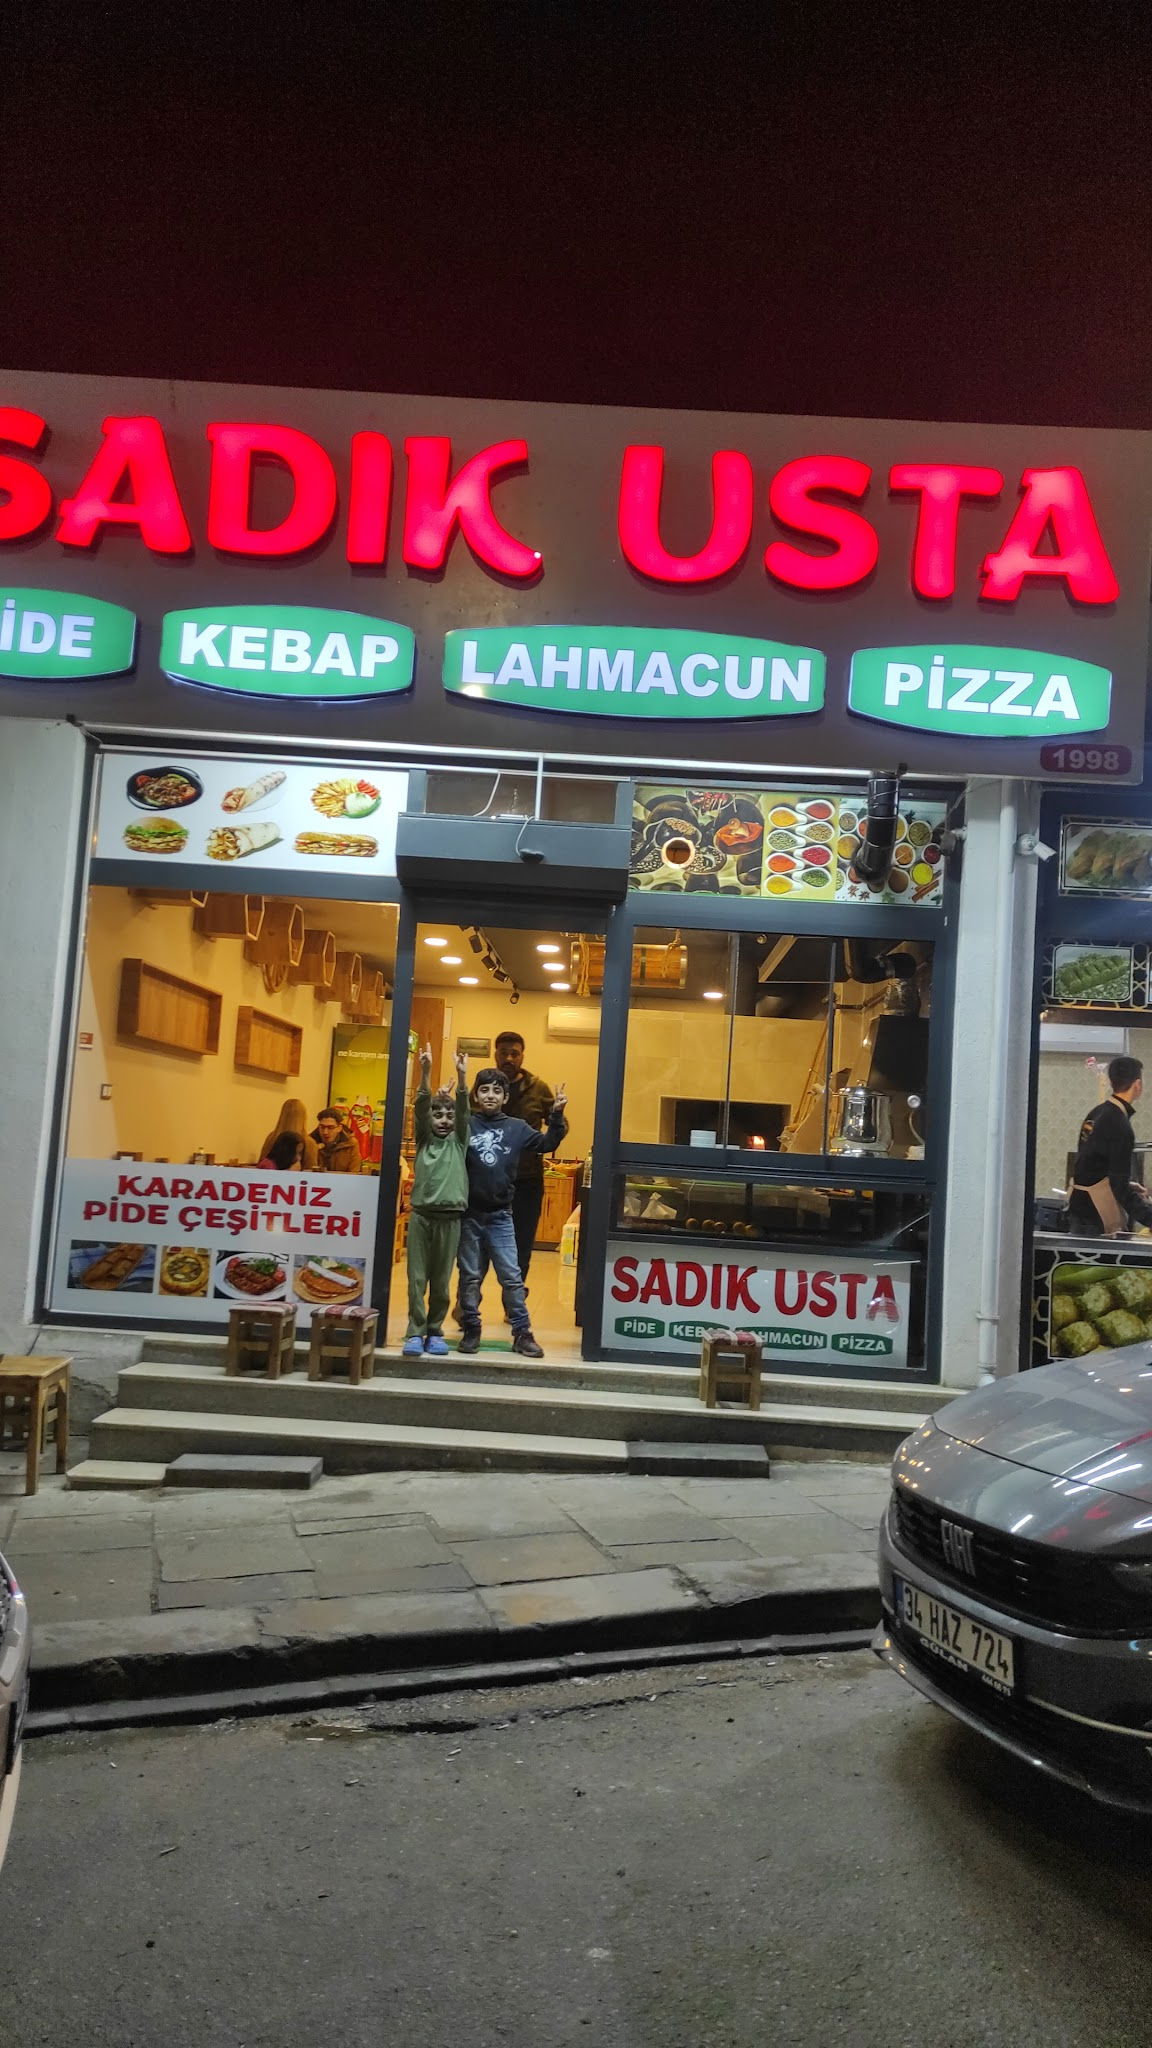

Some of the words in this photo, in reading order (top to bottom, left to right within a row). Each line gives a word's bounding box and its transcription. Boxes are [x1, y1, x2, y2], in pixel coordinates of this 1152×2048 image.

[617, 445, 1120, 604] USTA
[0, 599, 96, 659] İDE
[179, 621, 400, 679] KEBAP
[461, 640, 812, 703] LAHMACUN
[883, 655, 1082, 721] PİZZA
[1051, 747, 1121, 771] 1998
[83, 1196, 168, 1225] PİDE
[177, 1204, 362, 1238] ÇEŞİTLERİ
[117, 1174, 333, 1208] KARADENİZ
[611, 1256, 761, 1314] SADIK
[774, 1268, 901, 1323] USTA
[623, 1318, 657, 1334] PİDE
[672, 1324, 714, 1338] KEB
[750, 1331, 825, 1348] HMACUN
[838, 1336, 886, 1352] PİZZA
[940, 1519, 977, 1577] FIAT
[904, 1586, 923, 1628] 34
[929, 1601, 962, 1653] HAZ
[971, 1624, 1009, 1679] 724
